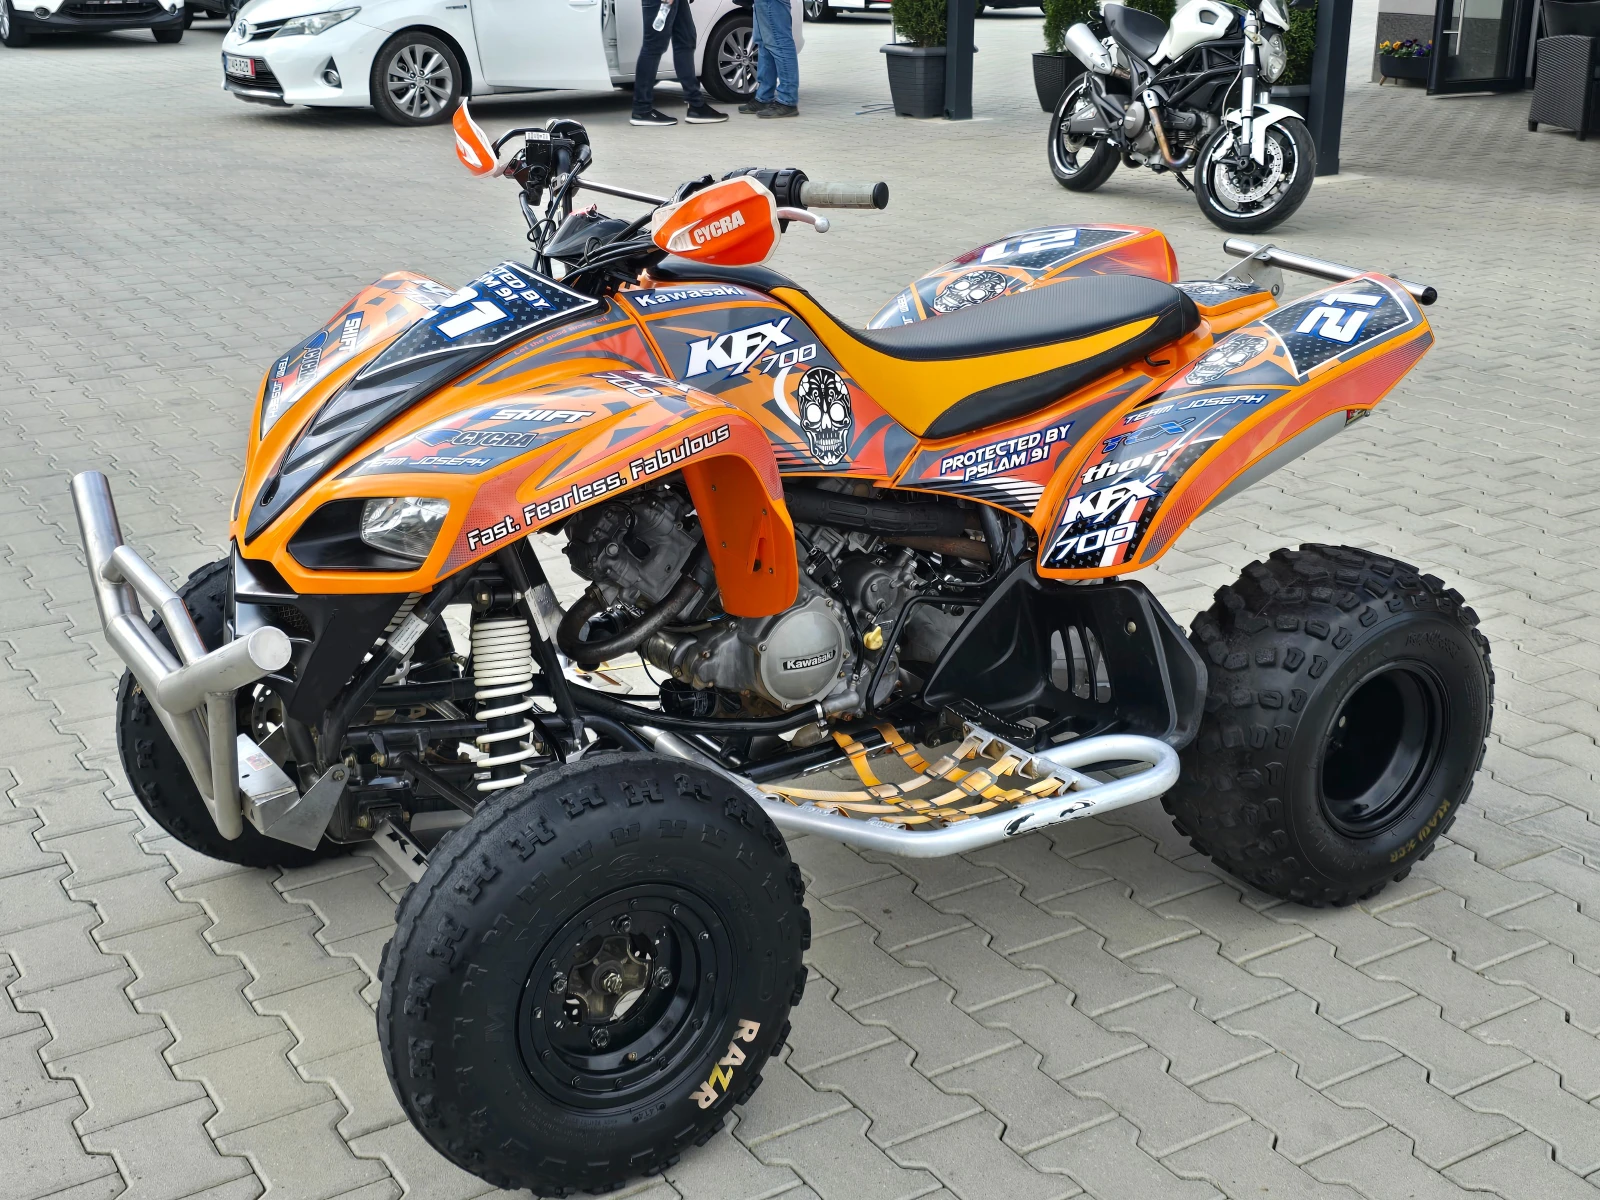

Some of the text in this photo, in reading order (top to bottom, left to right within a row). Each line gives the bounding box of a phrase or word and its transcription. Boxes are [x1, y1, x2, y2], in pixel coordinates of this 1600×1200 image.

[693, 210, 745, 244] CYCRA
[494, 287, 519, 301] 91
[520, 289, 551, 307] BY
[635, 286, 744, 307] Kawasaki
[338, 317, 362, 352] SHIFT
[683, 316, 797, 379] KFX
[761, 343, 817, 375] 700
[490, 409, 596, 424] SHIFT
[1125, 394, 1265, 424] TEAM JOSEPH
[451, 430, 539, 448] CYCRA
[941, 424, 1071, 474] PROTECTED BY
[409, 456, 492, 467] JOSEPH
[964, 446, 1050, 482] PSLAM 91
[1081, 449, 1168, 485] thor
[467, 424, 730, 551] Fast. Fearless. Fabulous
[1061, 473, 1162, 526] KFX
[1055, 521, 1137, 561] 700
[787, 651, 834, 669] Kawasaki
[688, 1018, 761, 1109] RAZR
